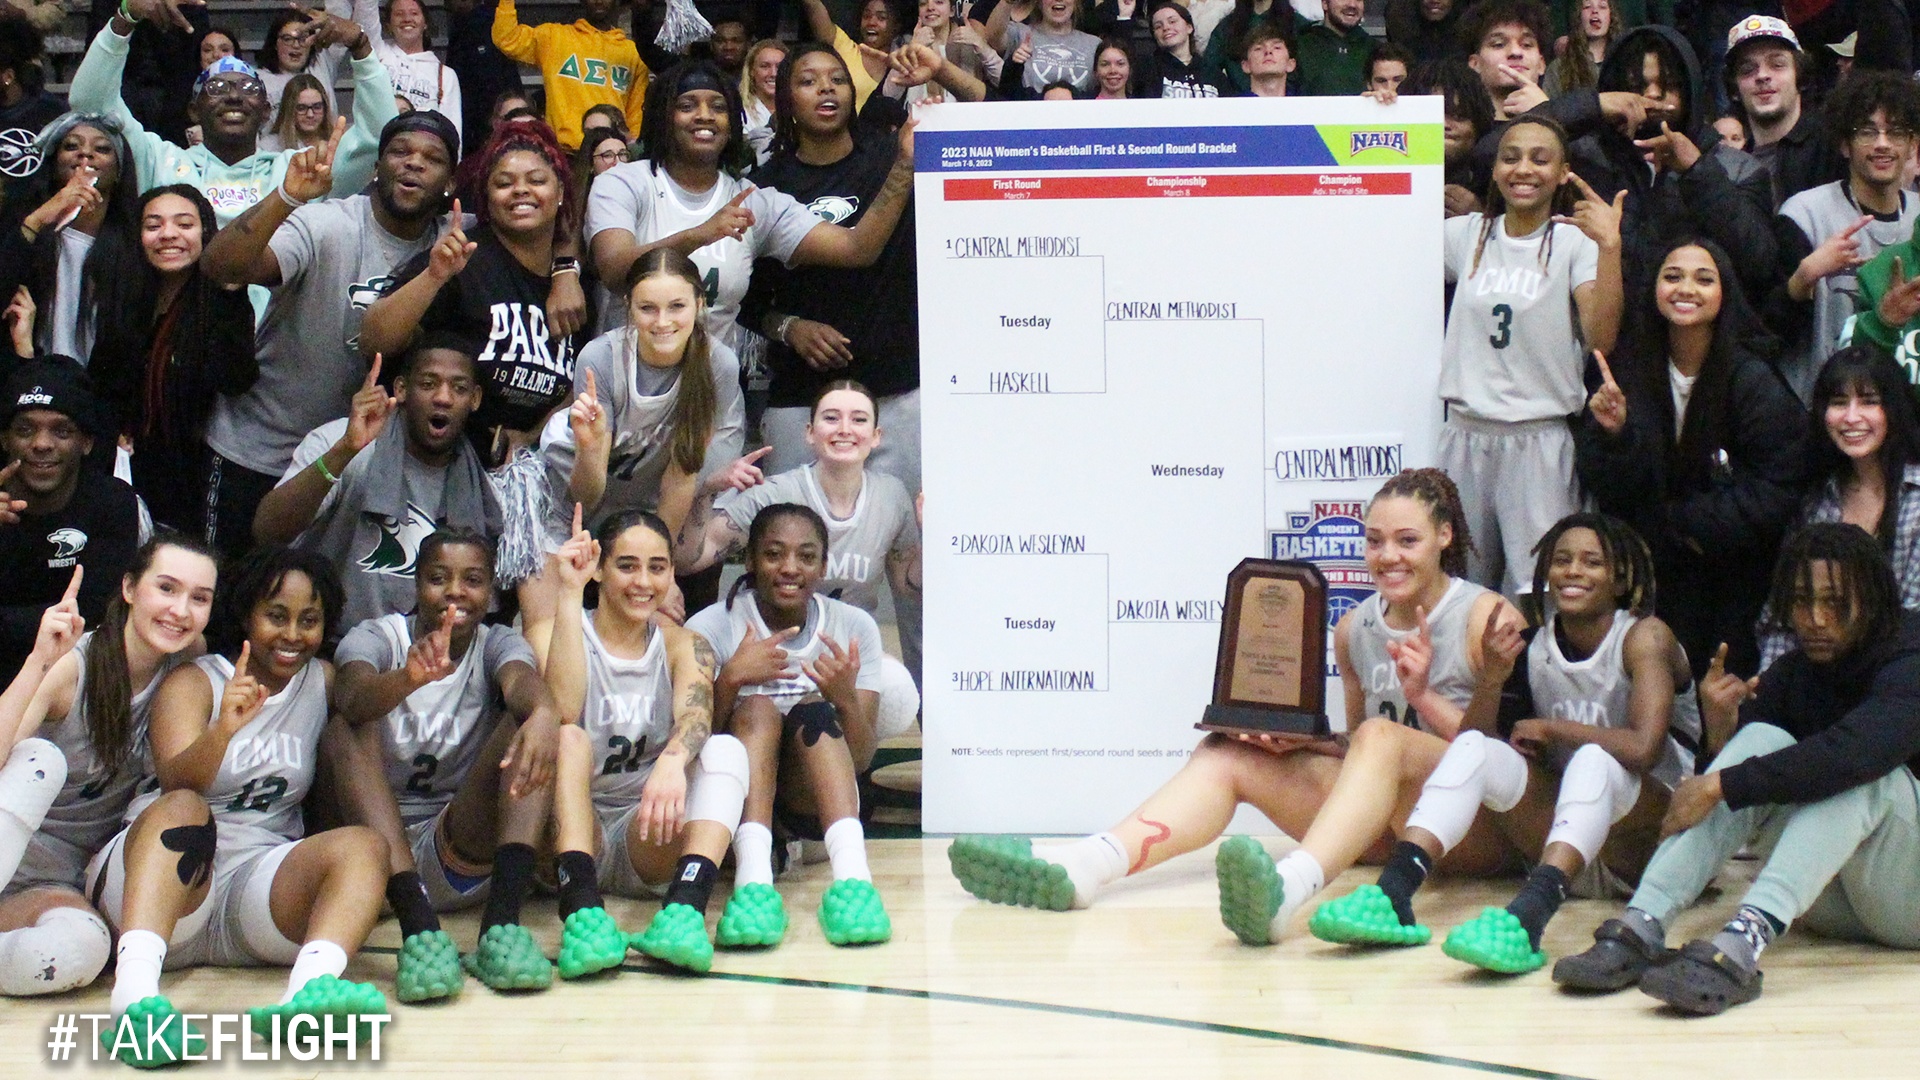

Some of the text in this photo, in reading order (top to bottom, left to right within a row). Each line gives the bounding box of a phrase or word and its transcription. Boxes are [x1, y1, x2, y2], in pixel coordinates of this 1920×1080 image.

[941, 142, 1237, 158] 2023 NAIA Women's Basketball First & Second Round Bracket
[1352, 132, 1407, 152] NAIA
[942, 160, 961, 168] March
[976, 159, 993, 167] 2023
[993, 179, 1042, 190] First Round
[1147, 176, 1207, 188] Championship
[1319, 174, 1363, 186] Champion
[1004, 192, 1025, 200] March
[1163, 189, 1191, 197] March 8
[1328, 187, 1336, 195] to
[1337, 187, 1353, 195] Final
[1354, 187, 1368, 195] Site
[946, 236, 1081, 258] 1 CENTRAL METHODIST
[1477, 267, 1542, 300] CMU
[1106, 301, 1237, 320] CENTRAL METHODIST
[1000, 315, 1052, 330] Tuesday
[1490, 304, 1513, 350] 3
[493, 368, 508, 383] 19
[510, 366, 557, 395] FRANCE
[950, 371, 1051, 393] 4 HASKELL
[1151, 464, 1225, 479] Wednesday
[1275, 443, 1403, 480] CENTRAL METHODIST
[1314, 503, 1363, 521] NAIA
[951, 534, 1085, 554] 2 DAKOTA WESLEYAN
[1275, 536, 1366, 560] BASKETB
[824, 552, 870, 583] MU
[1117, 599, 1225, 620] DAKOTA WESLEY
[1004, 617, 1056, 632] Tuesday
[952, 669, 1097, 691] 3 HOPE INTERNATIONAL
[598, 694, 657, 727] CMU
[395, 711, 461, 746] CMU
[231, 730, 302, 774] CMU
[602, 735, 647, 775] 21
[951, 748, 974, 756] NOTE:
[976, 747, 1003, 757] Seeds
[1006, 748, 1049, 758] represent
[1051, 747, 1105, 758] first/second
[1107, 748, 1134, 757] round
[1137, 748, 1163, 757] seeds
[1166, 748, 1183, 757] and
[406, 753, 440, 793] 2
[226, 775, 289, 813] 12
